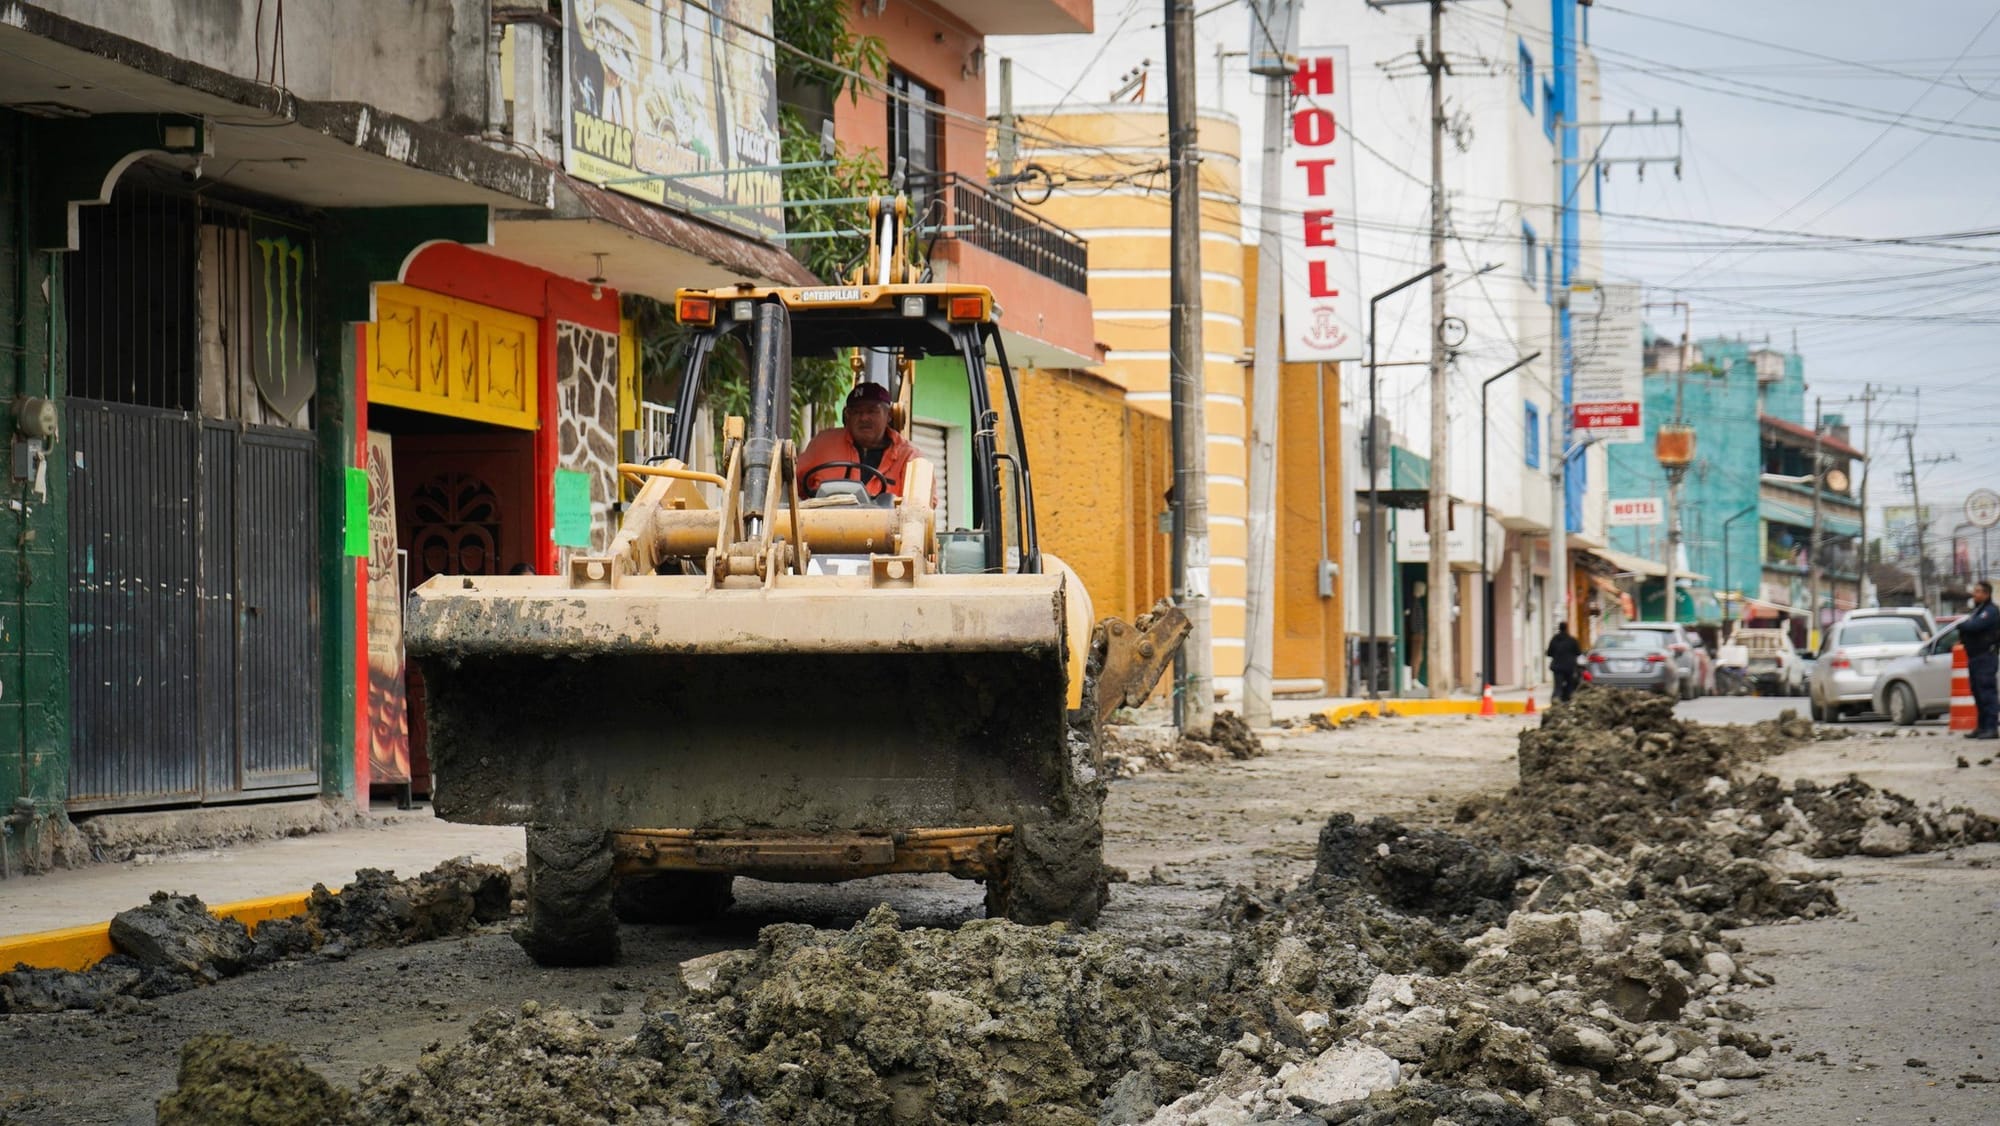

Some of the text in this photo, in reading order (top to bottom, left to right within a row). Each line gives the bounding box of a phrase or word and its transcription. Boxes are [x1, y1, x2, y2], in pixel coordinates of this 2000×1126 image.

[574, 110, 632, 166] TORTAS
[736, 125, 766, 164] TACOS
[727, 157, 781, 222] PASTOR
[1291, 57, 1338, 297] HOTEL
[803, 290, 860, 301] CATERPILLAR
[368, 520, 388, 533] DORA
[1614, 502, 1656, 515] HOTEL
